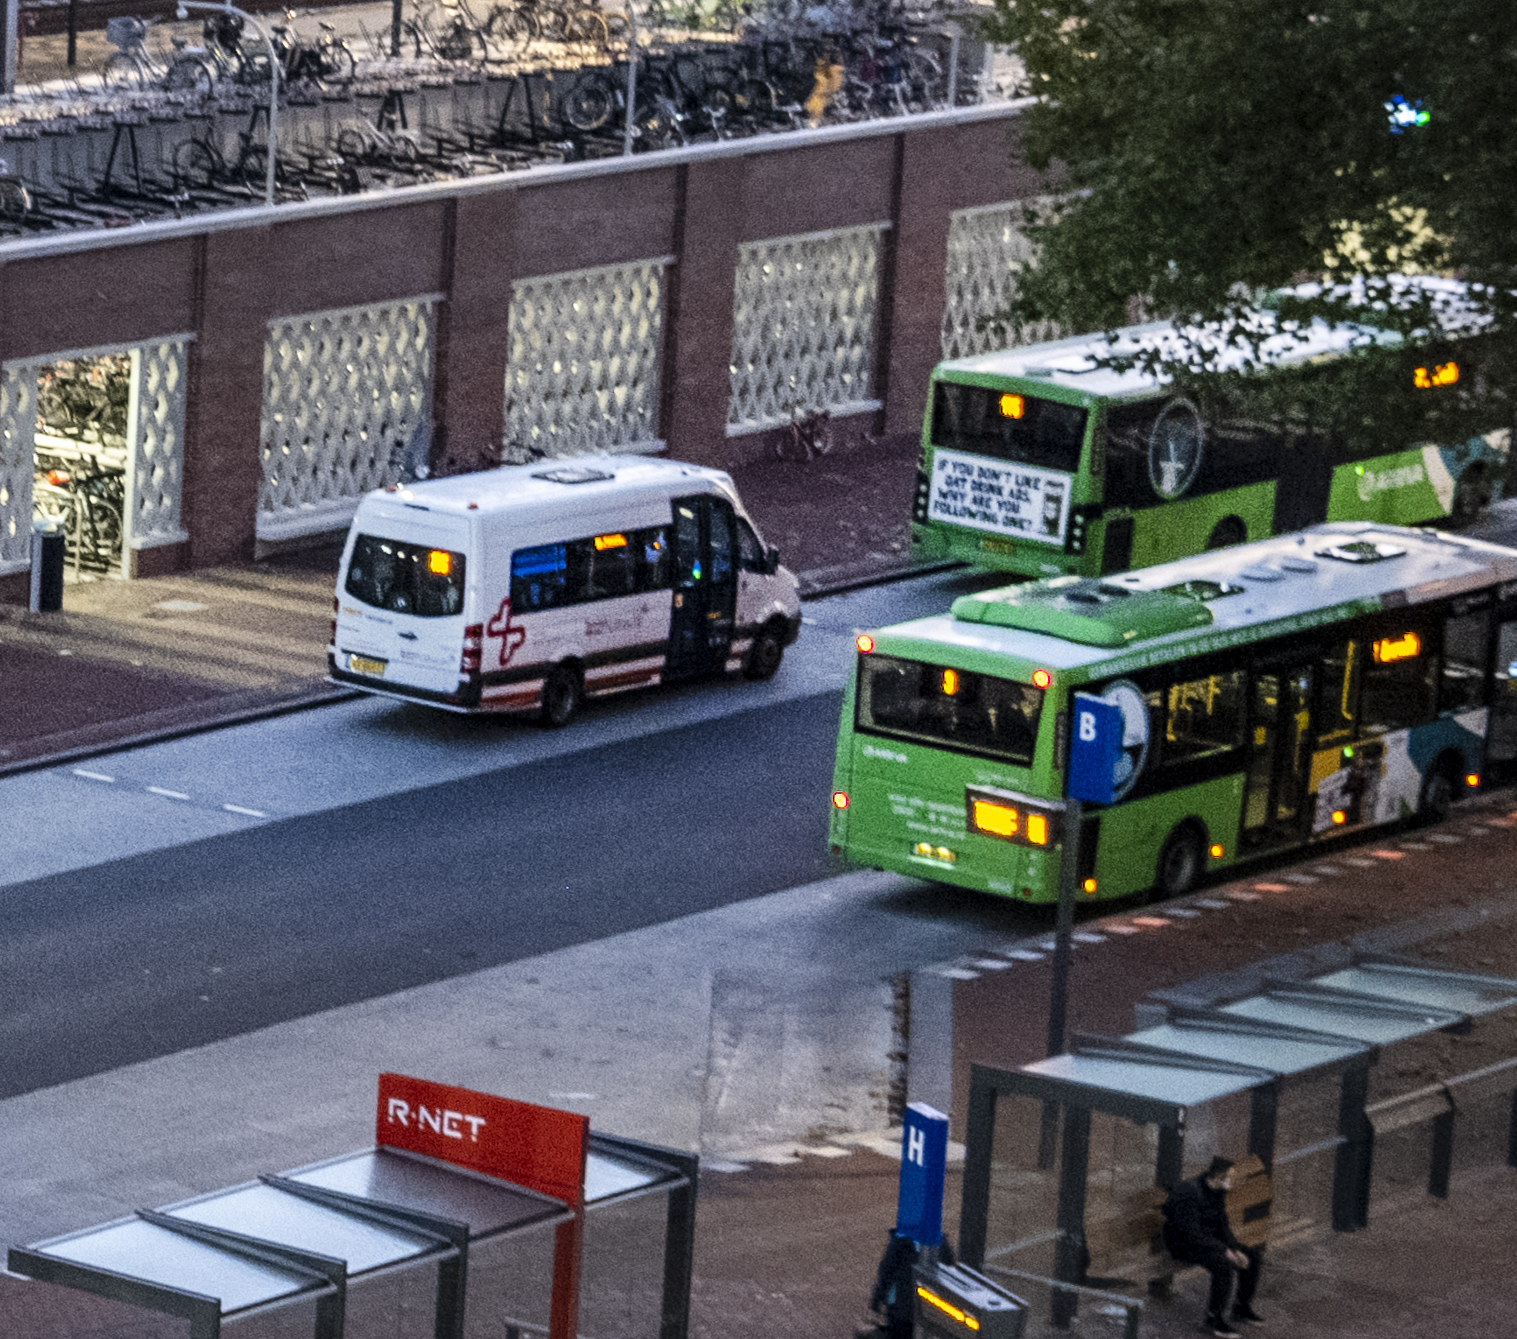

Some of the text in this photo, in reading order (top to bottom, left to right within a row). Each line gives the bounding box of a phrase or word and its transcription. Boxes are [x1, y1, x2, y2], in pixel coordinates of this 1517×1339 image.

[952, 461, 975, 476] YOU
[1015, 474, 1042, 491] LIKE
[972, 494, 993, 509] ARE
[998, 500, 1021, 514] YOU
[1079, 711, 1097, 742] B
[908, 1125, 926, 1167] H
